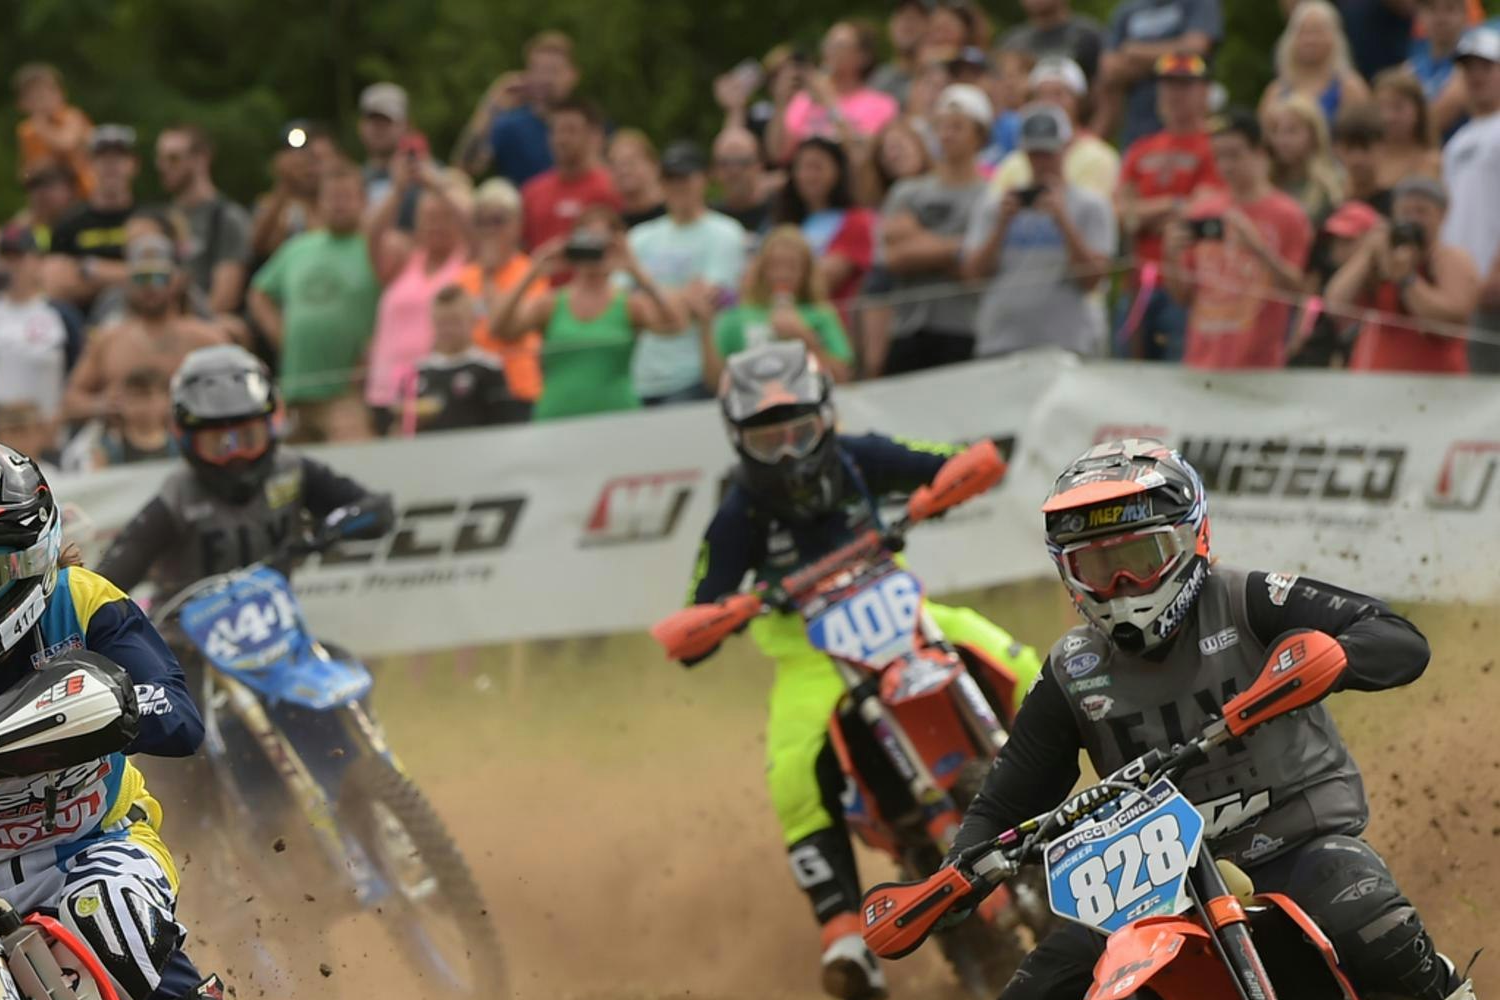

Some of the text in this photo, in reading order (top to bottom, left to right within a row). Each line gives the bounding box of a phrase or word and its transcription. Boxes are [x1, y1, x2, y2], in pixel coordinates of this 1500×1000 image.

[13, 604, 36, 635] 417
[823, 570, 920, 663] 406
[1195, 790, 1269, 839] TM
[1069, 814, 1188, 927] 828
